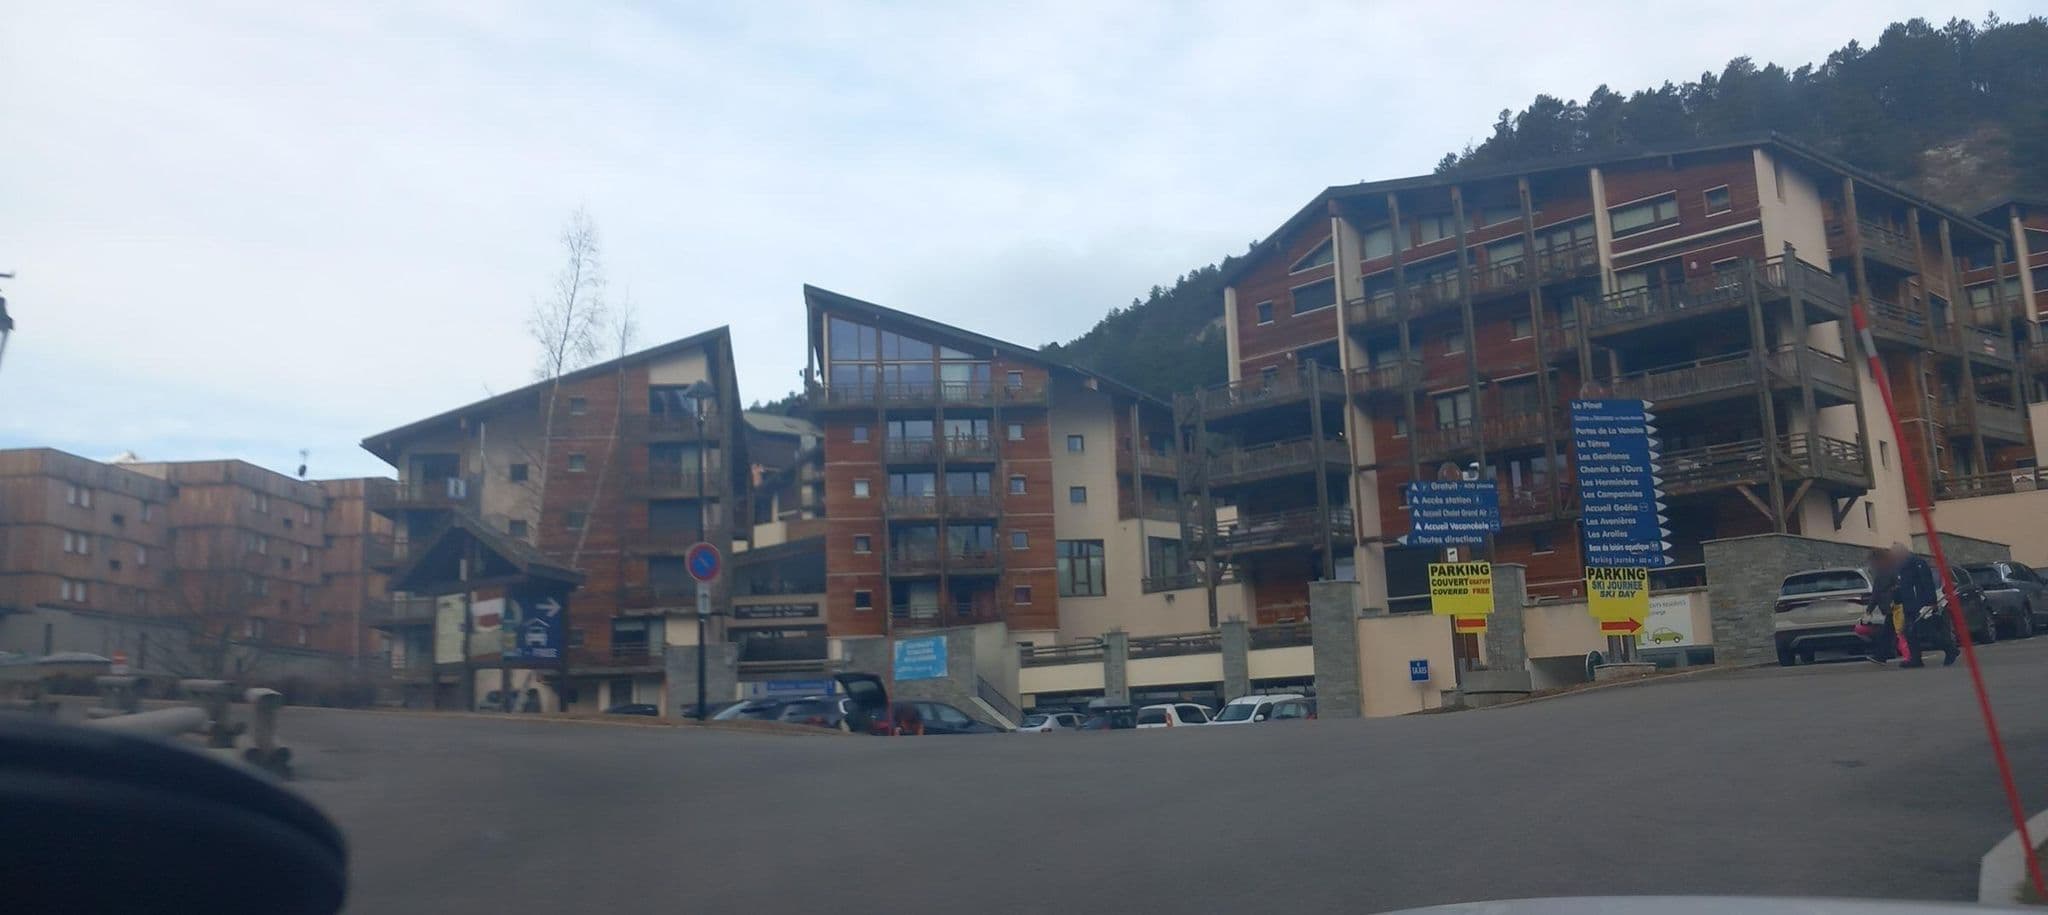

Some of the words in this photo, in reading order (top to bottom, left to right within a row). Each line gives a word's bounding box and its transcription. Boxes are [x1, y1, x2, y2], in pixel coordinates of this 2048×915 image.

[1431, 482, 1458, 491] Gratuit
[1597, 490, 1643, 499] Campanules
[1422, 496, 1443, 504] Accès
[1445, 496, 1471, 504] station
[1585, 503, 1611, 512] Accueil
[1424, 522, 1448, 530] Accueil
[1418, 536, 1442, 544] Toutes
[1445, 535, 1482, 543] directions
[1591, 557, 1612, 565] Parking
[1430, 564, 1489, 576] PARKING
[1587, 568, 1645, 580] PARKING
[1432, 578, 1469, 586] COUVERT
[1592, 581, 1605, 590] SKI
[1618, 590, 1636, 598] DAY
